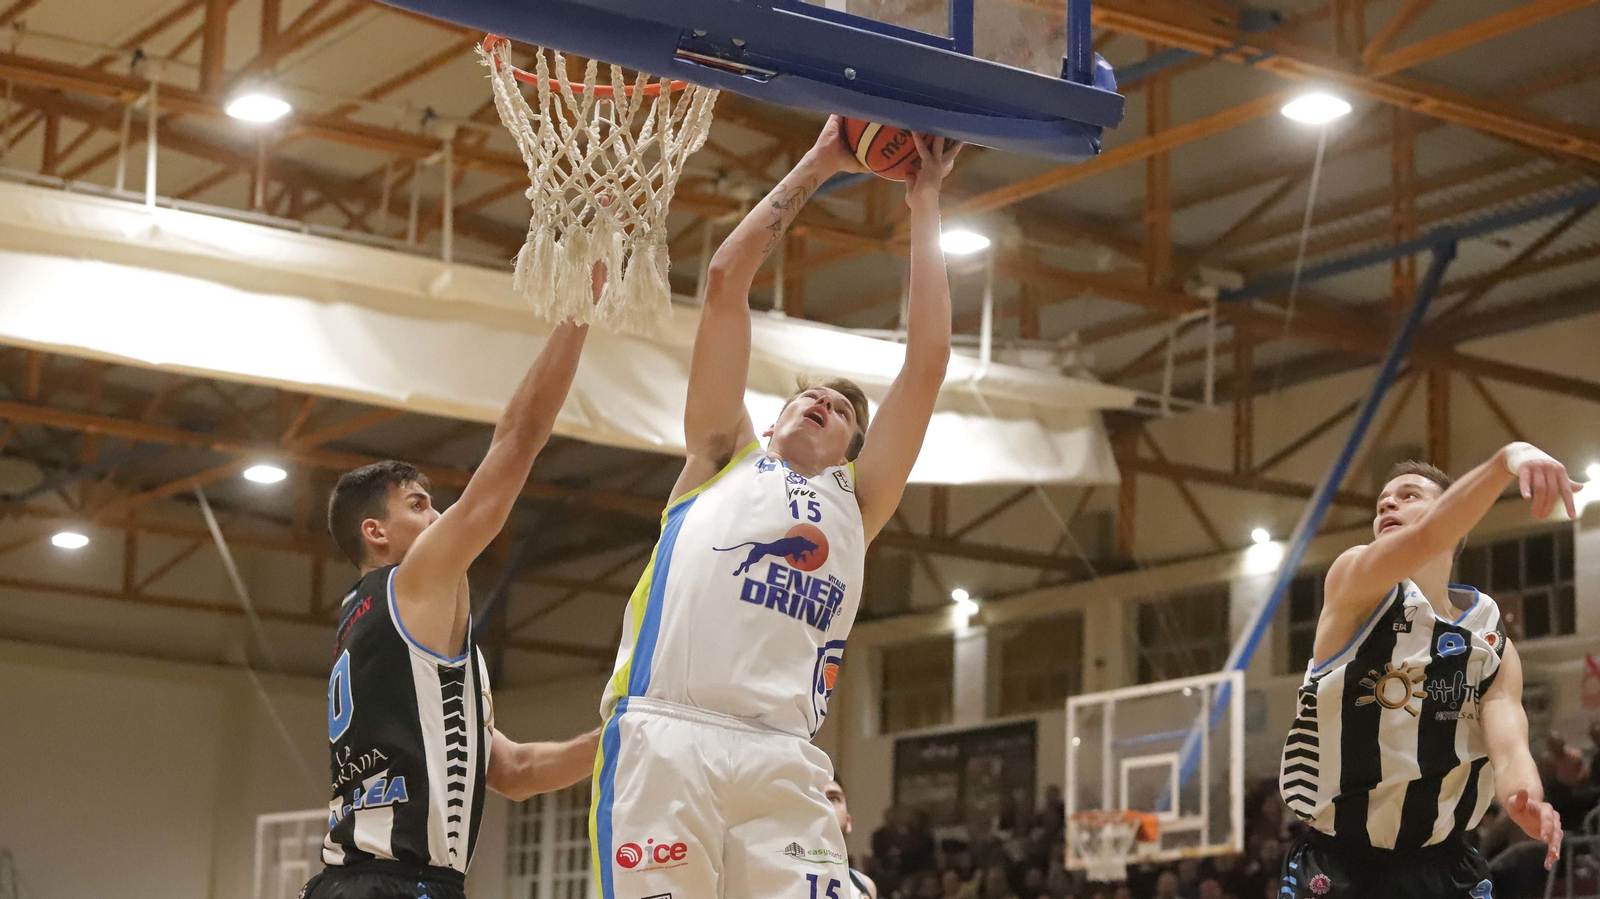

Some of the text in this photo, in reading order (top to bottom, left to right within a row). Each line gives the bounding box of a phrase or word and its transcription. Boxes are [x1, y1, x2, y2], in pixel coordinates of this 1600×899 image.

[880, 129, 913, 160] mol
[789, 499, 821, 523] 15
[766, 561, 844, 614] ENER
[828, 574, 847, 591] VITALIS
[335, 745, 351, 767] LA
[645, 838, 688, 863] ice
